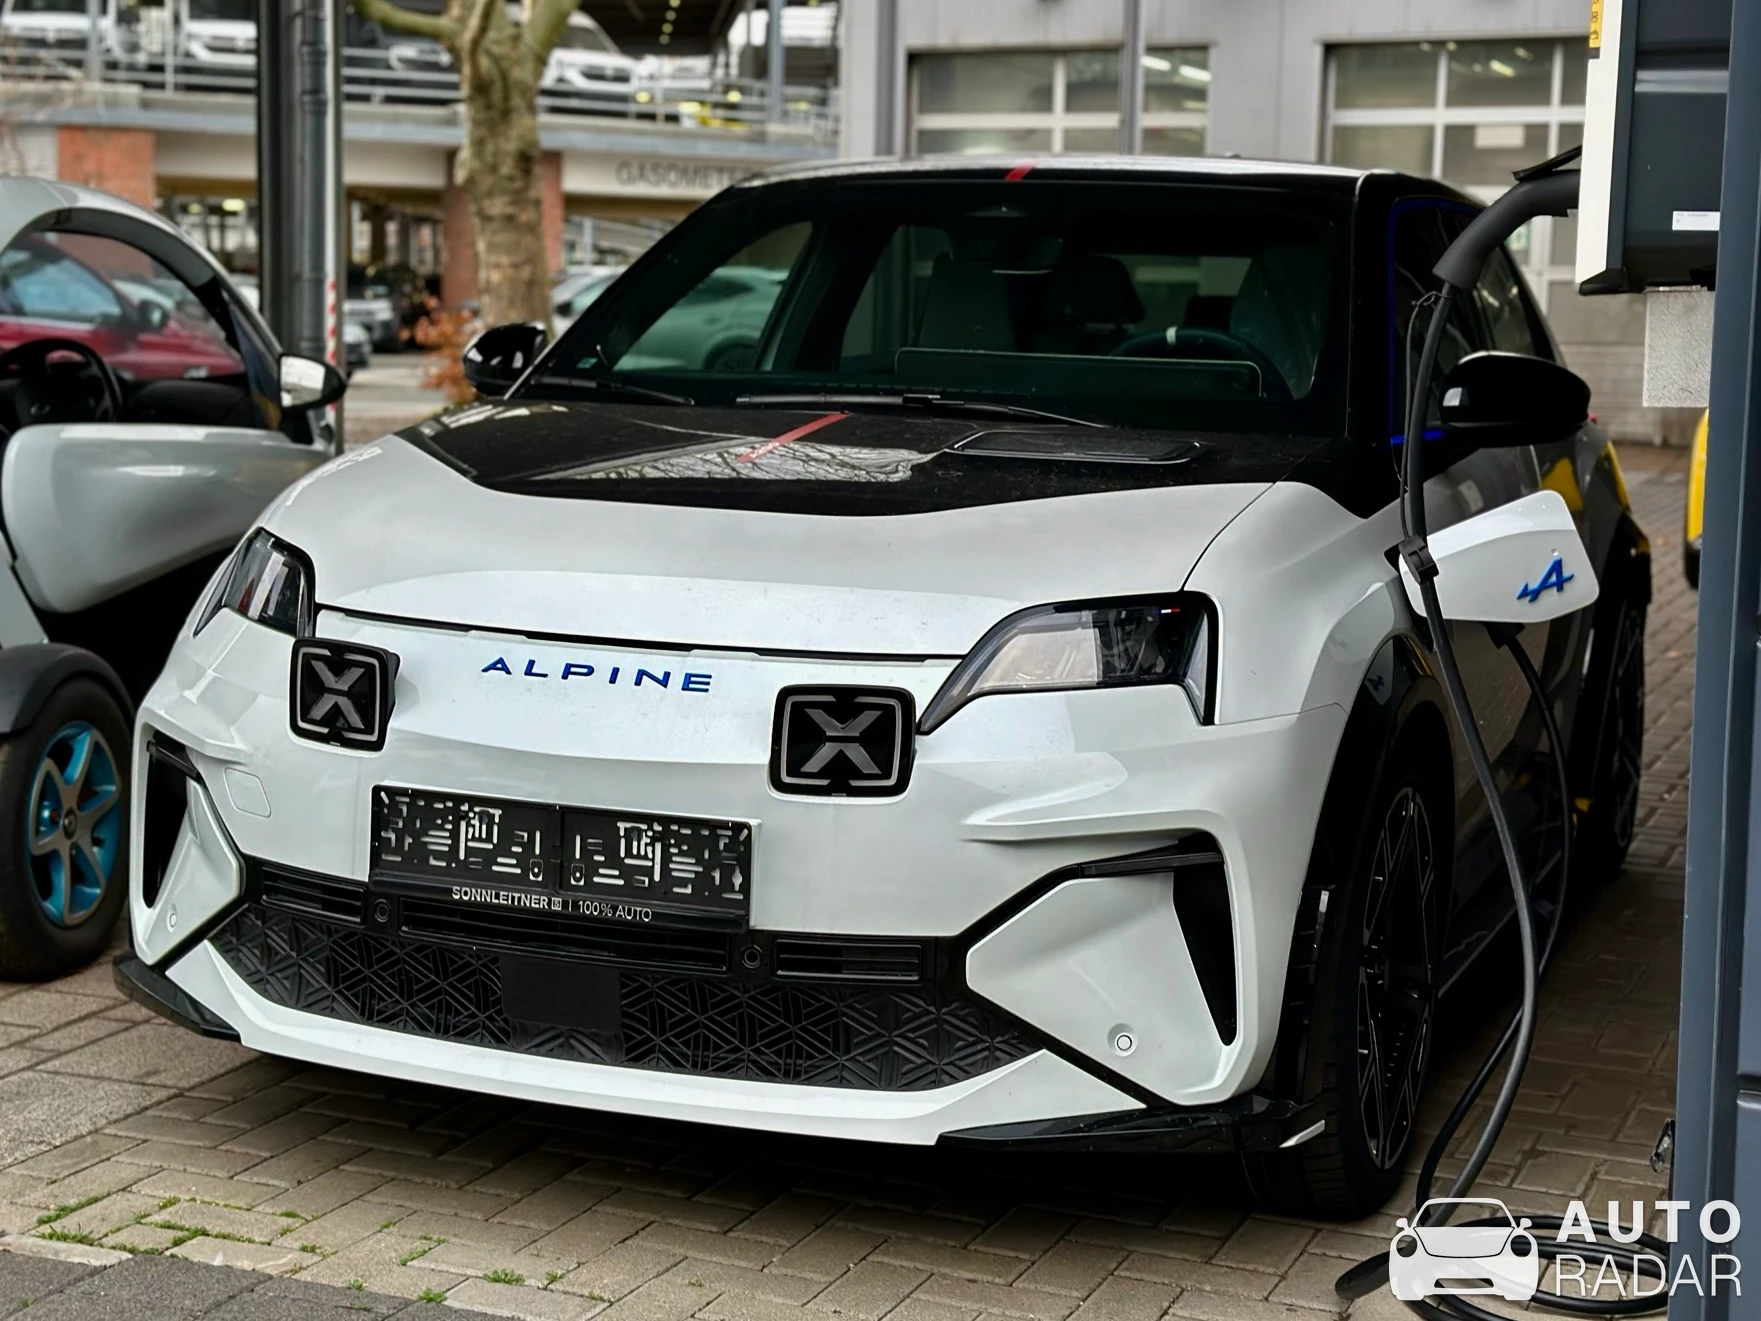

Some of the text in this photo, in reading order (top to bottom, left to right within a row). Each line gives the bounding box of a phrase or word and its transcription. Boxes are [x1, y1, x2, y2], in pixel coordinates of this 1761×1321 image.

[481, 656, 713, 693] ALPINE
[452, 886, 549, 909] SONNLEITNER
[578, 900, 613, 917] 100%
[615, 906, 652, 922] AUTO
